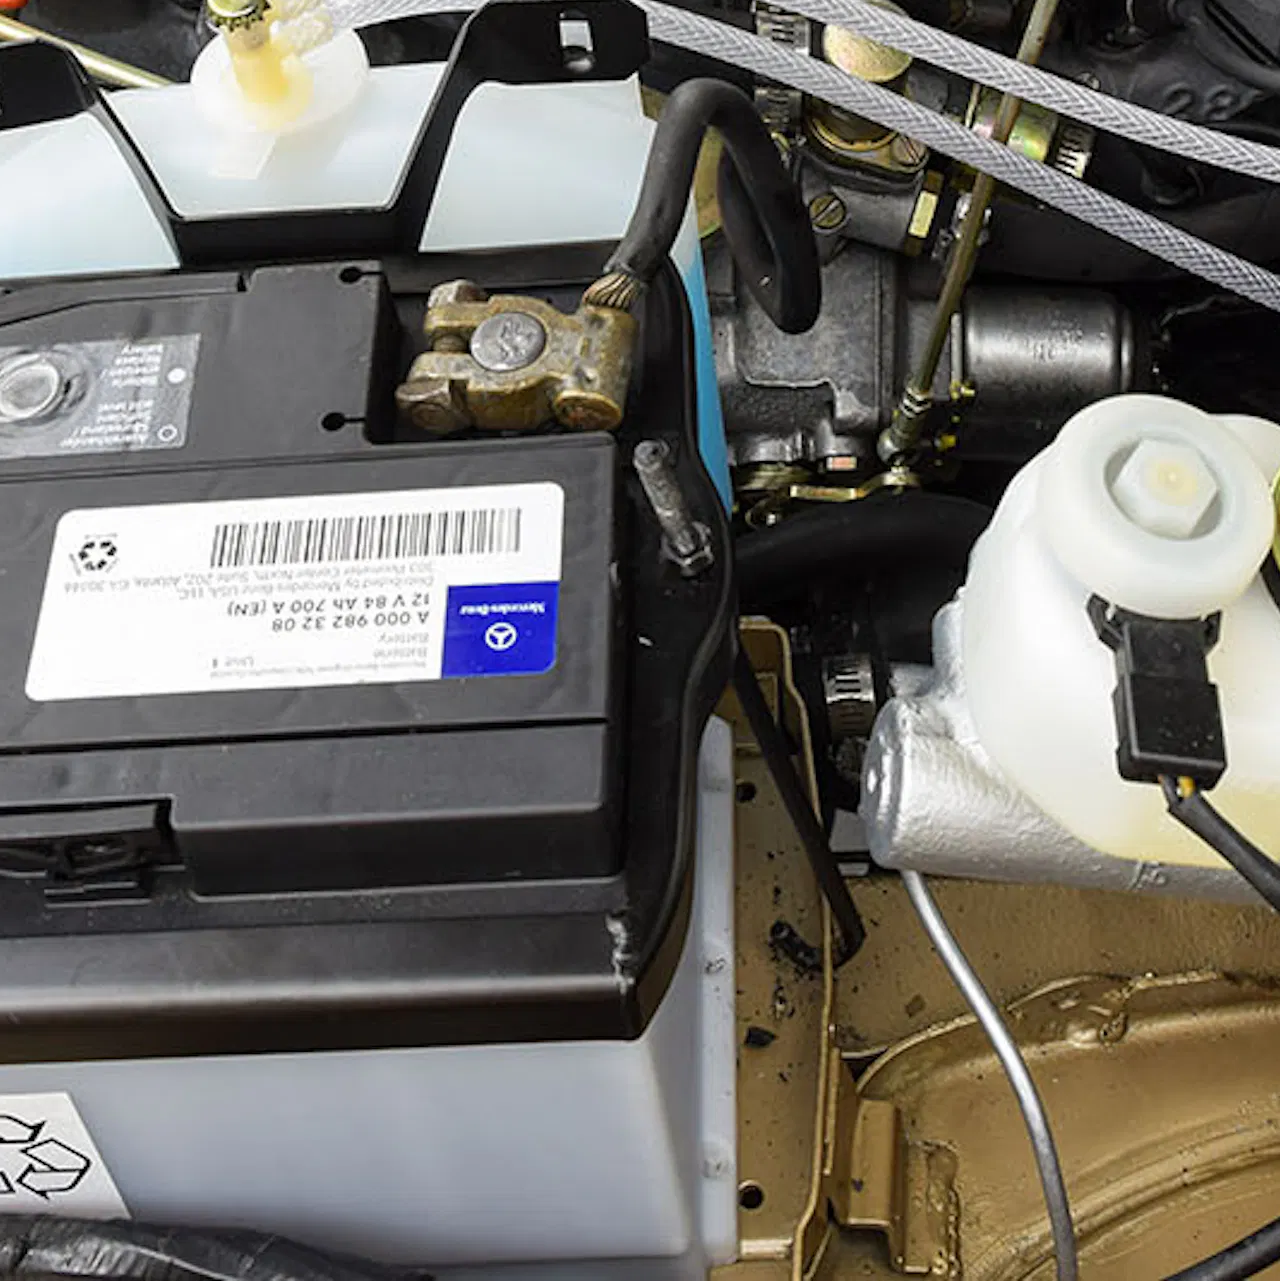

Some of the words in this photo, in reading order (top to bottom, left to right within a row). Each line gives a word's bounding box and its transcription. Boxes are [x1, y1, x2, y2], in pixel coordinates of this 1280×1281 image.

[290, 599, 327, 613] 700
[332, 597, 358, 611] Ah
[363, 595, 388, 609] 84
[392, 594, 406, 608] V
[411, 593, 431, 607] 12
[227, 599, 268, 617] (EN)
[272, 601, 286, 615] A
[271, 618, 297, 632] 08
[301, 616, 326, 631] 32
[331, 614, 369, 629] 982
[374, 611, 411, 626] 000
[417, 611, 431, 625] A
[376, 632, 430, 645] Battery
